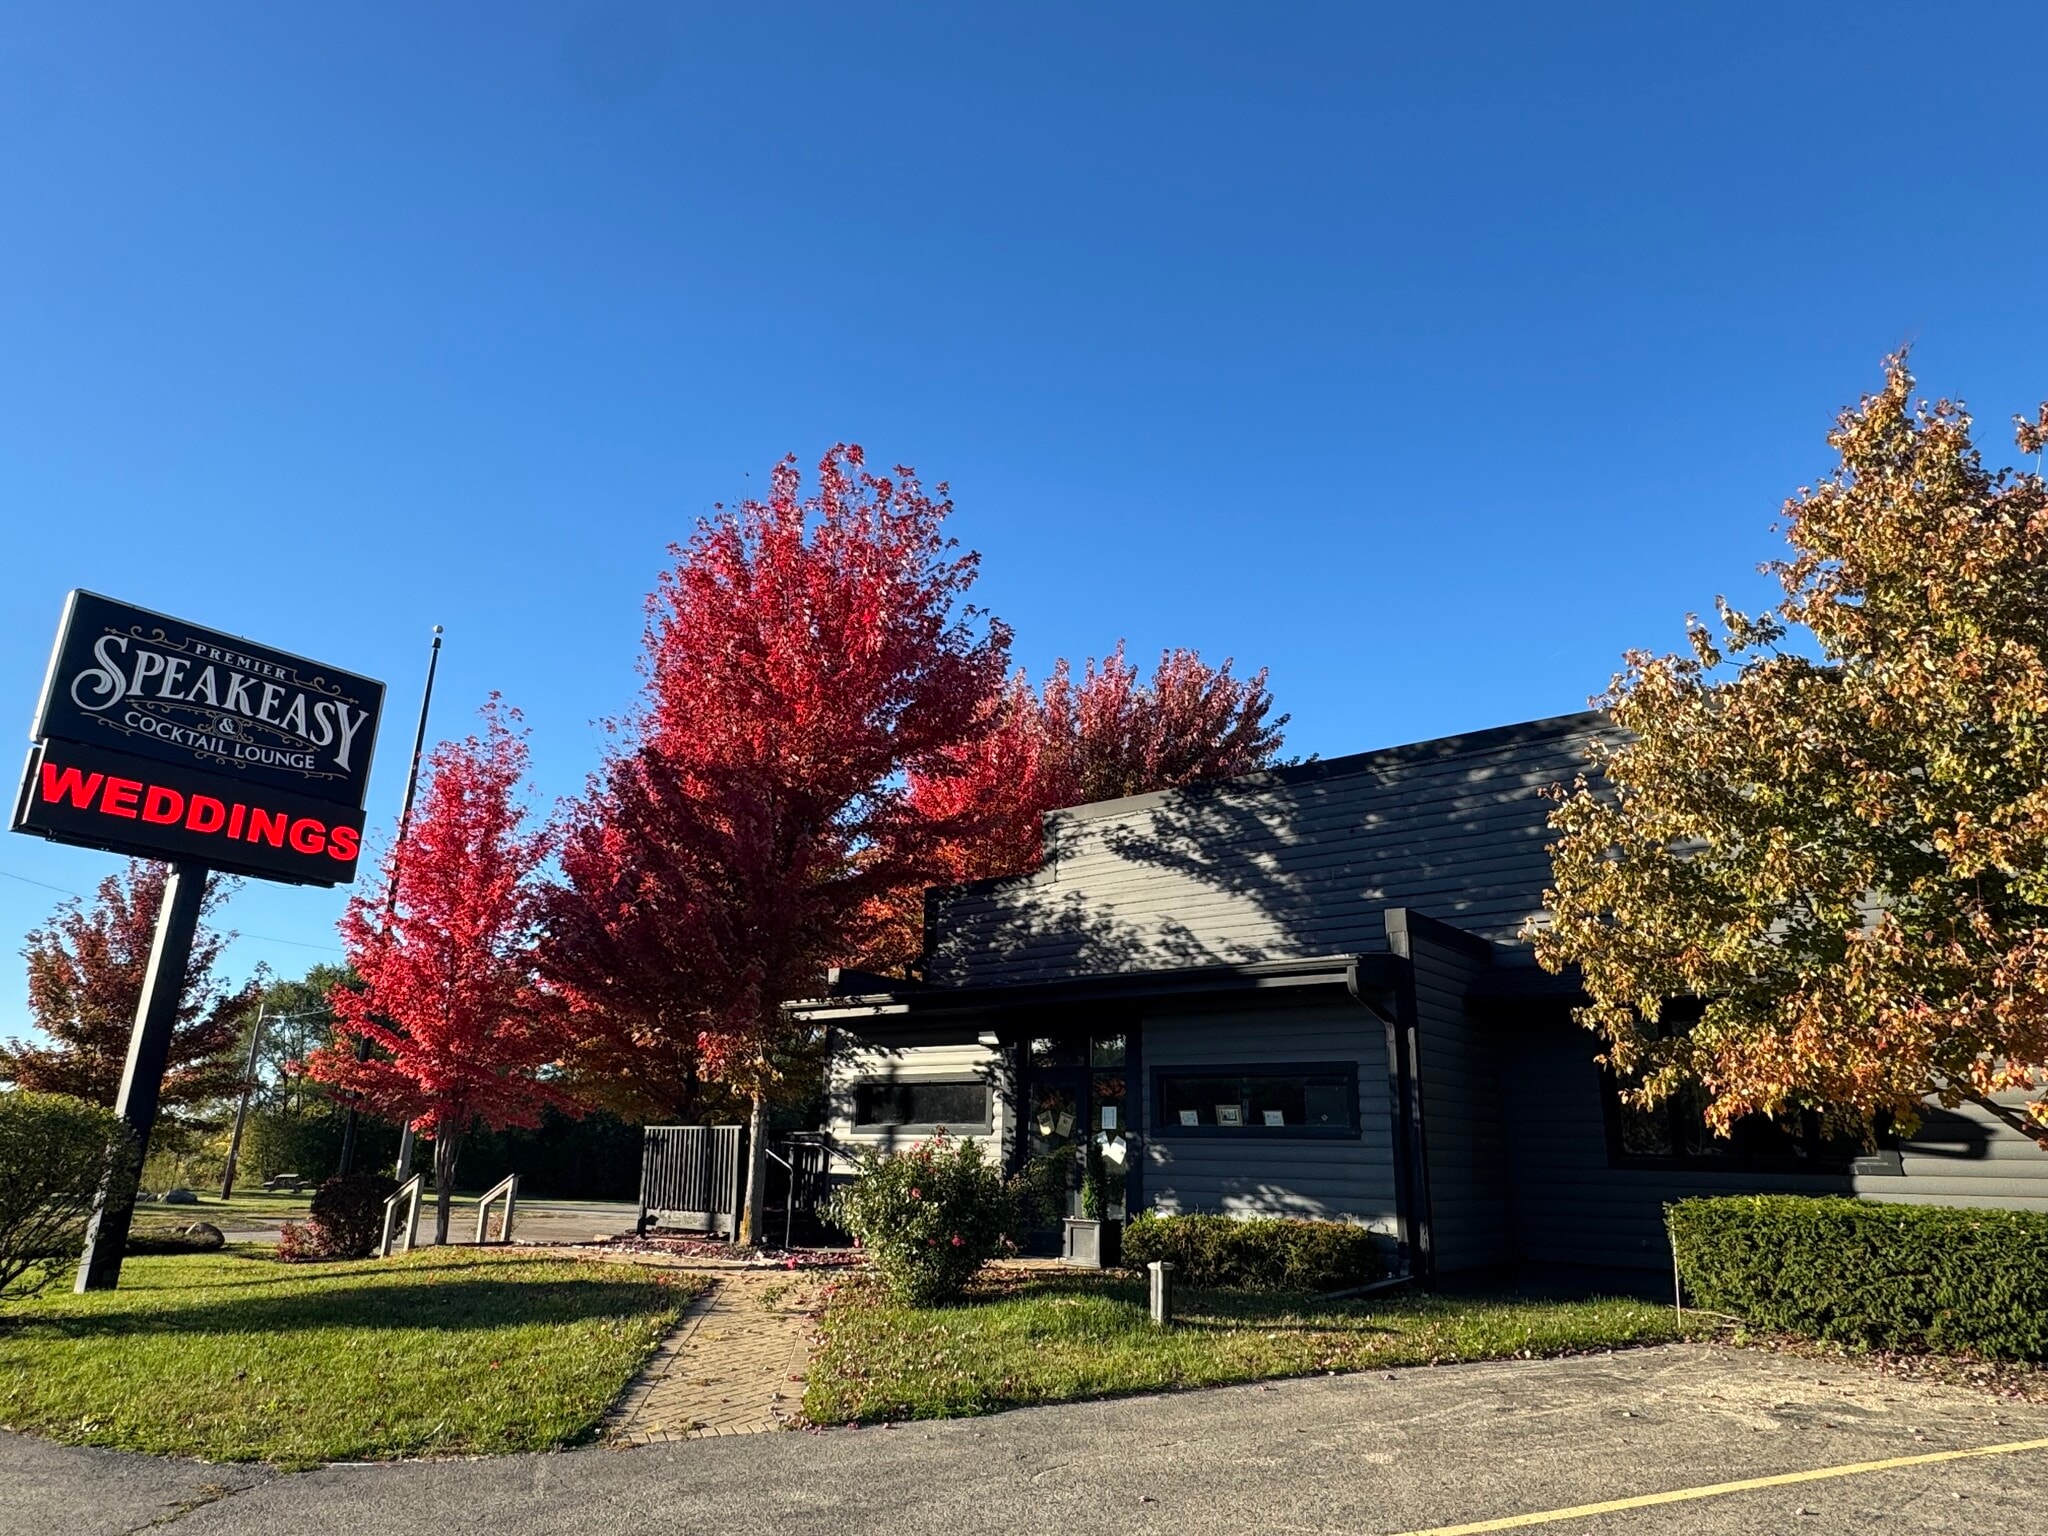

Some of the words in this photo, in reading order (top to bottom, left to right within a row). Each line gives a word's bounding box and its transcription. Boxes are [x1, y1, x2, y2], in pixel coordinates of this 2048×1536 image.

[195, 643, 286, 680] PREMIER
[71, 635, 370, 772] SPEAKEASY
[219, 718, 236, 734] &
[124, 711, 228, 754] COCKTAIL
[234, 743, 315, 769] LOUNGE
[41, 761, 359, 861] WEDDINGS
